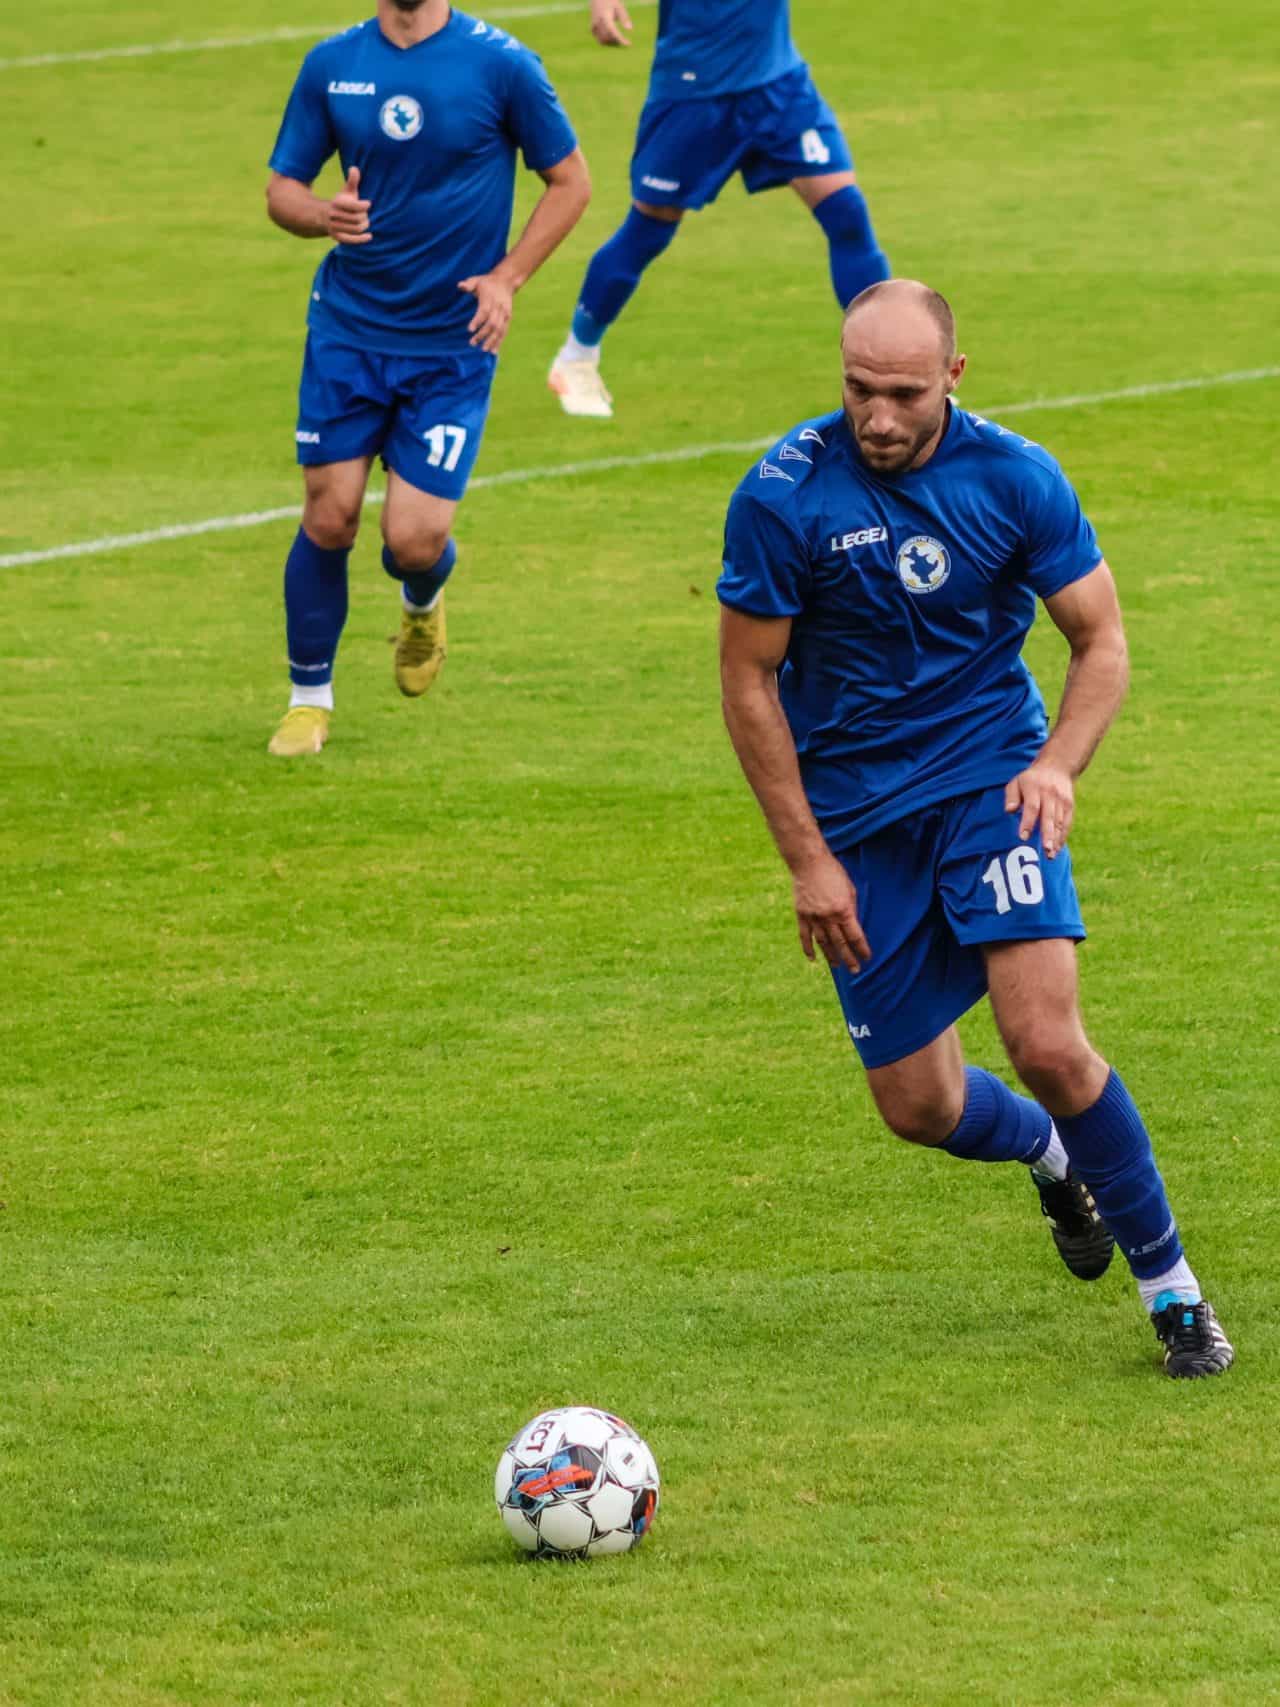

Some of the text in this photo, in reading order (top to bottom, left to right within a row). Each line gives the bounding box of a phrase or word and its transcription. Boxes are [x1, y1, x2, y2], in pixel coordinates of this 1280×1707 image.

[801, 128, 830, 165] 4
[423, 424, 468, 472] 17
[981, 845, 1045, 915] 16
